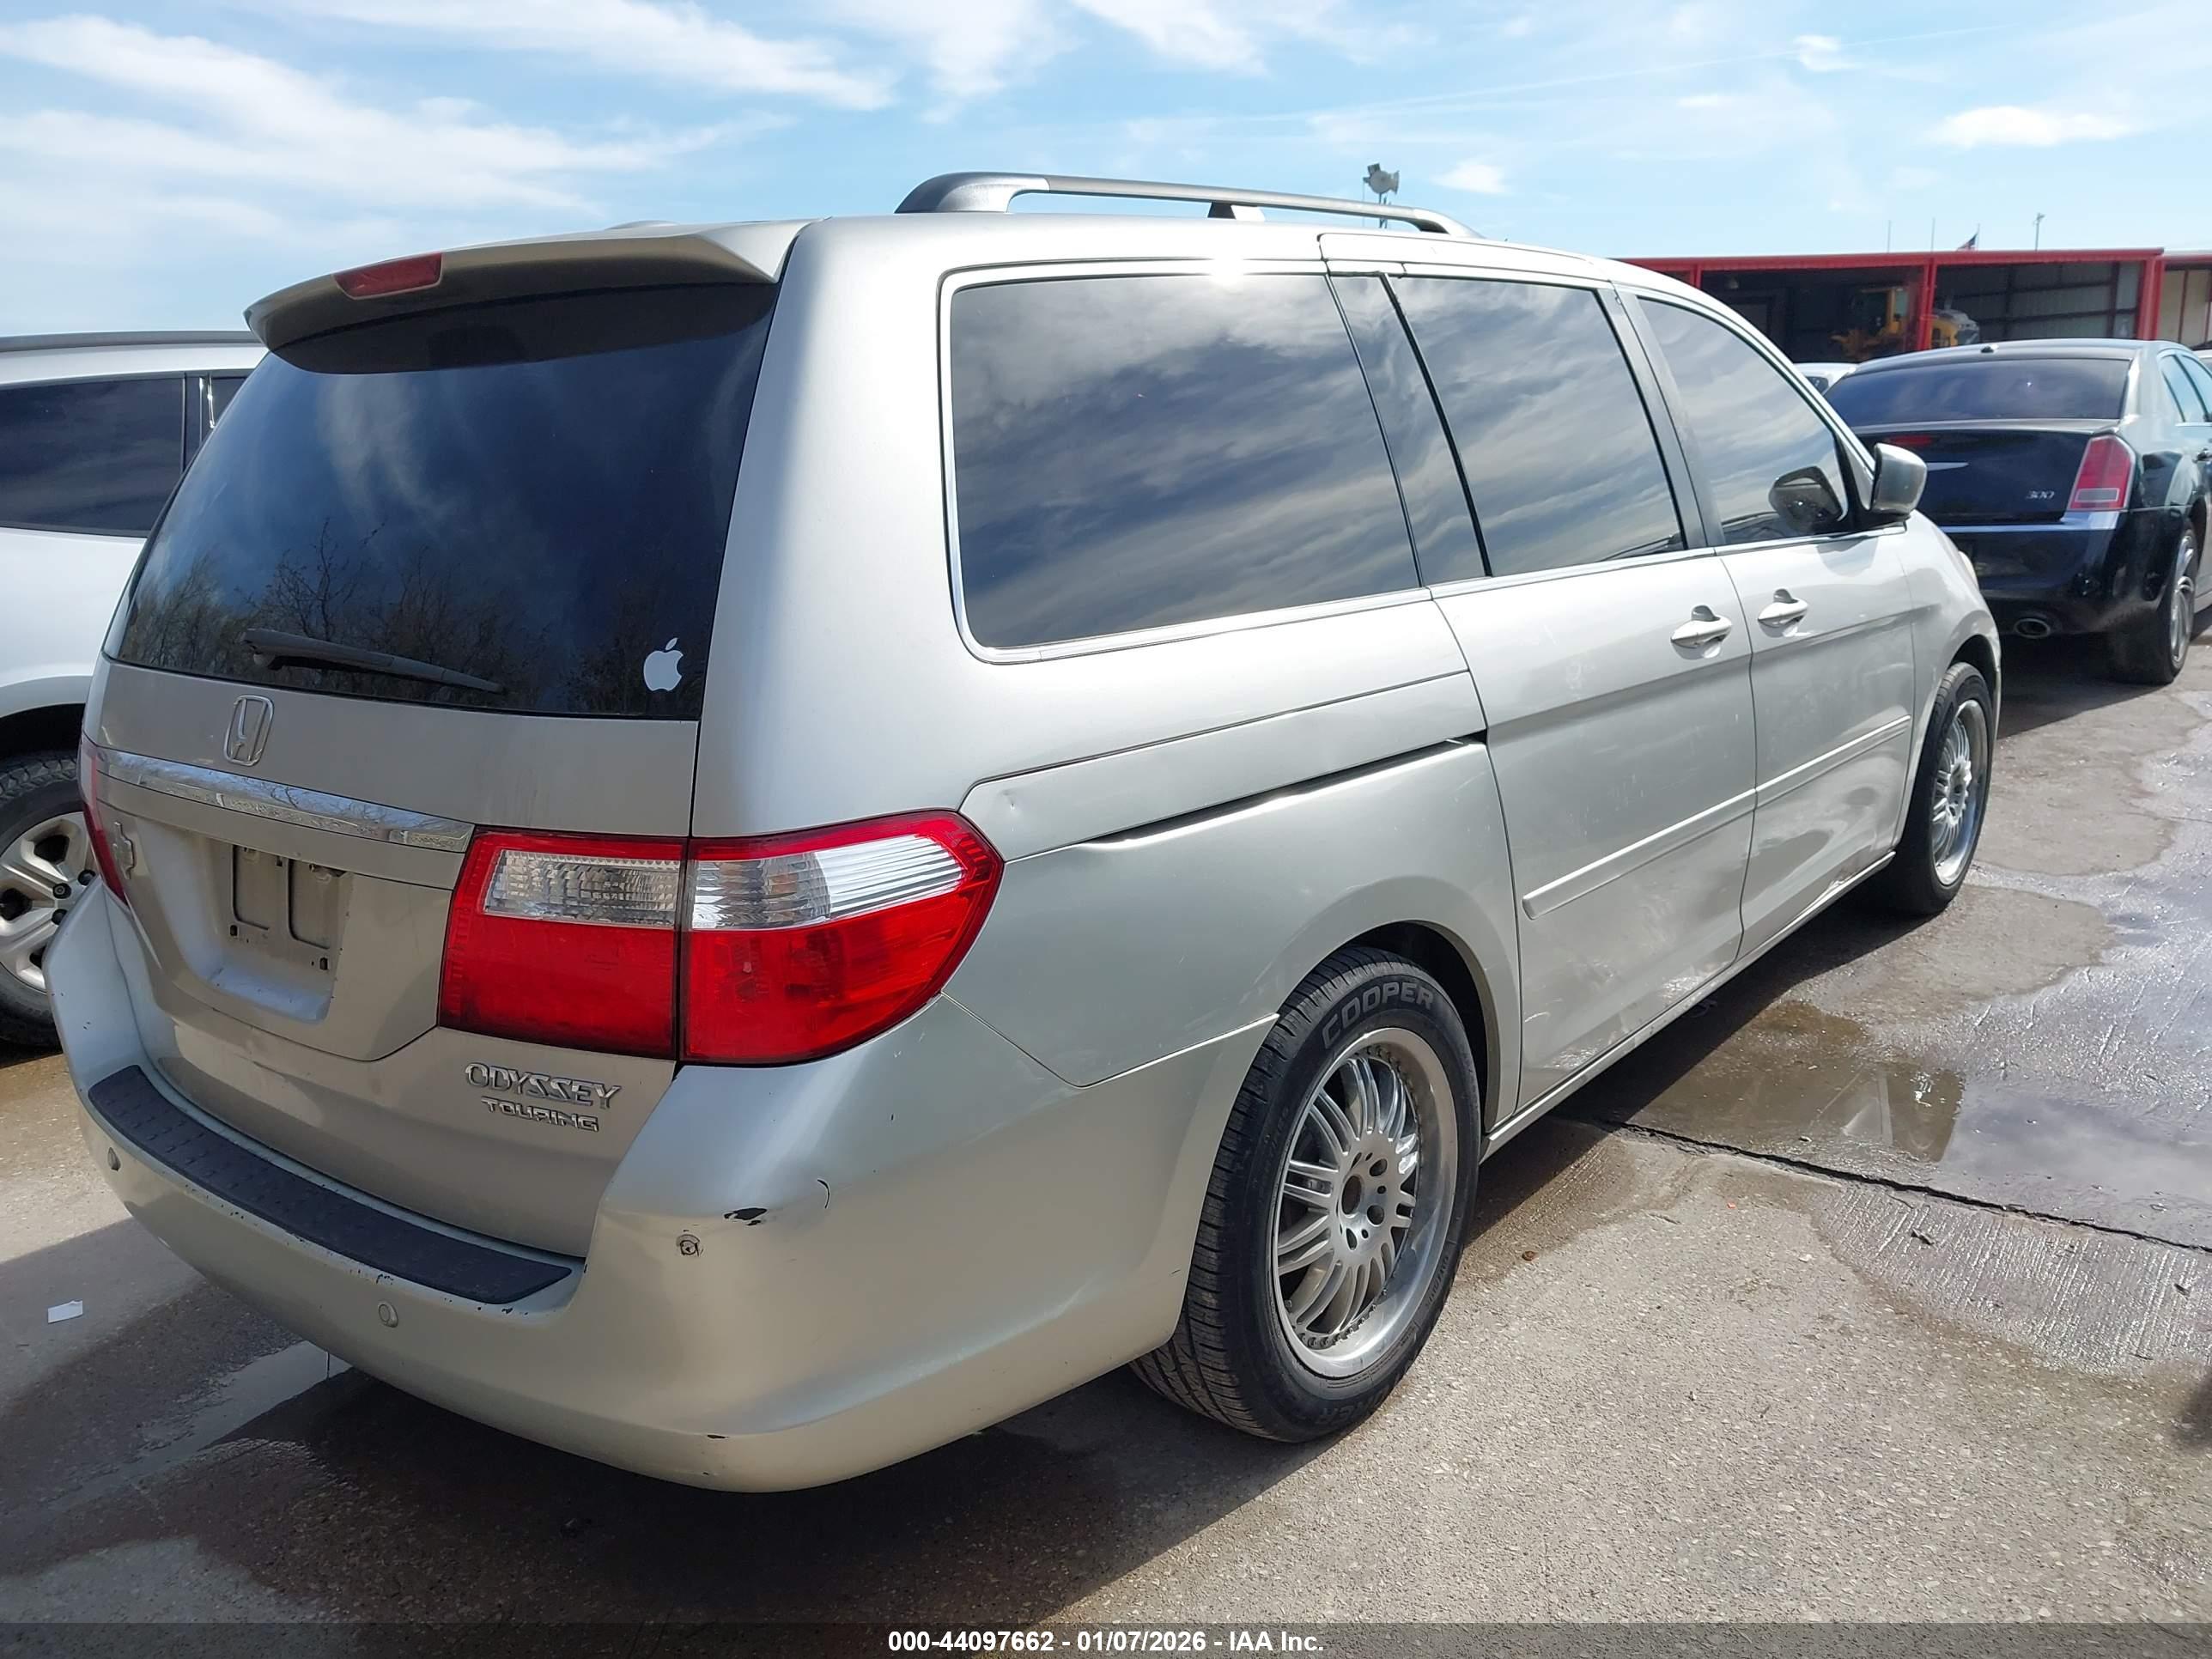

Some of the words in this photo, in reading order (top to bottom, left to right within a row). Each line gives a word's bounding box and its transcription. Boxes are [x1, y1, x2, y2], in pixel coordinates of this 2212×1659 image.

[1322, 981, 1434, 1049] COOPER
[465, 1062, 622, 1109] ODYSSEY
[481, 1096, 599, 1132] TOURING
